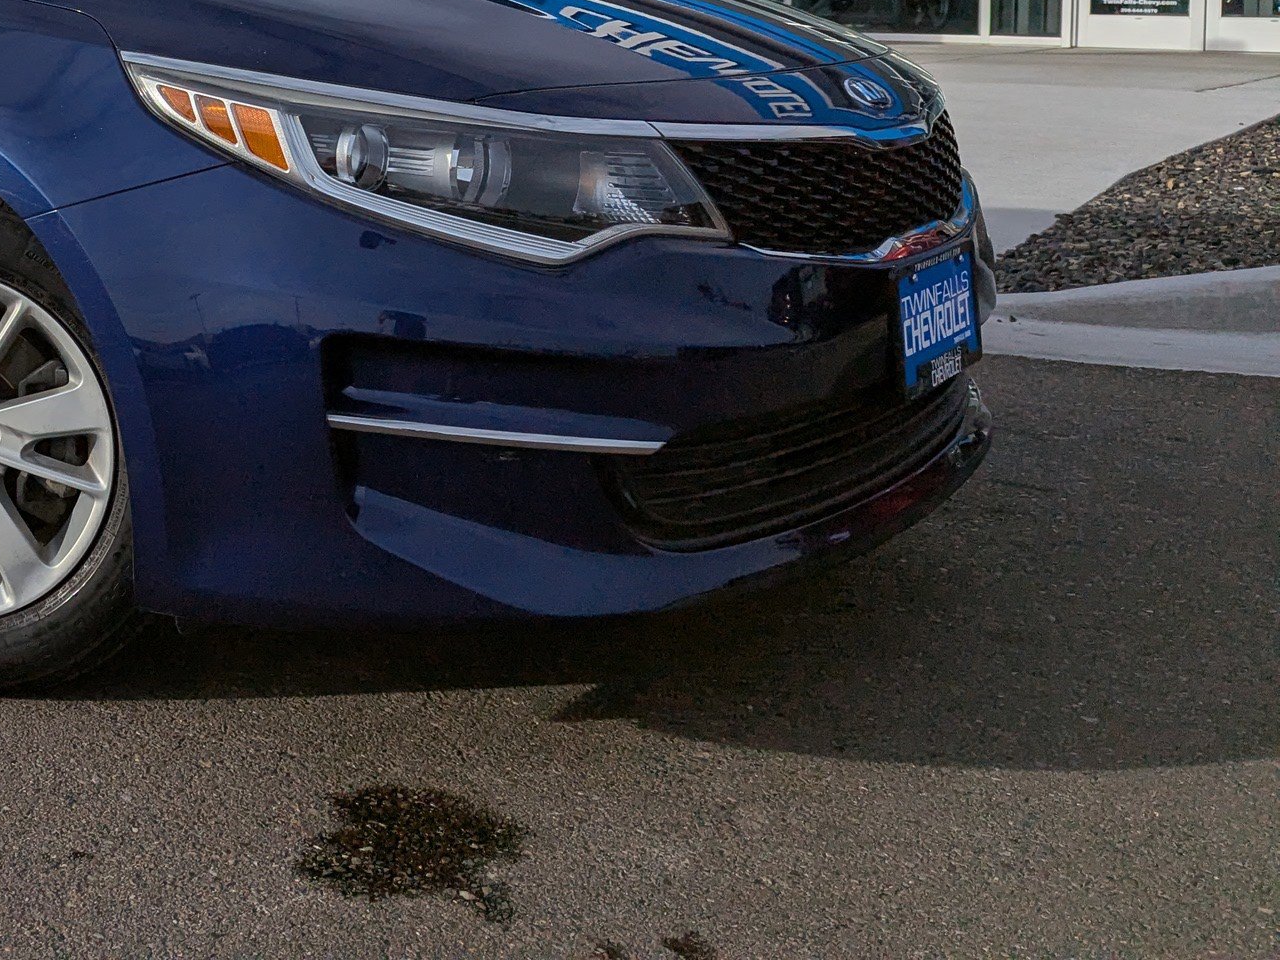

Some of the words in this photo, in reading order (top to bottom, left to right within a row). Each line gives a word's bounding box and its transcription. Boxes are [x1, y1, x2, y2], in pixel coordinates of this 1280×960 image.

[901, 270, 969, 318] TWINFALLS
[903, 290, 971, 358] CHEVROLET
[930, 345, 962, 370] TWINFALLS
[931, 355, 962, 387] CHEVROLET
